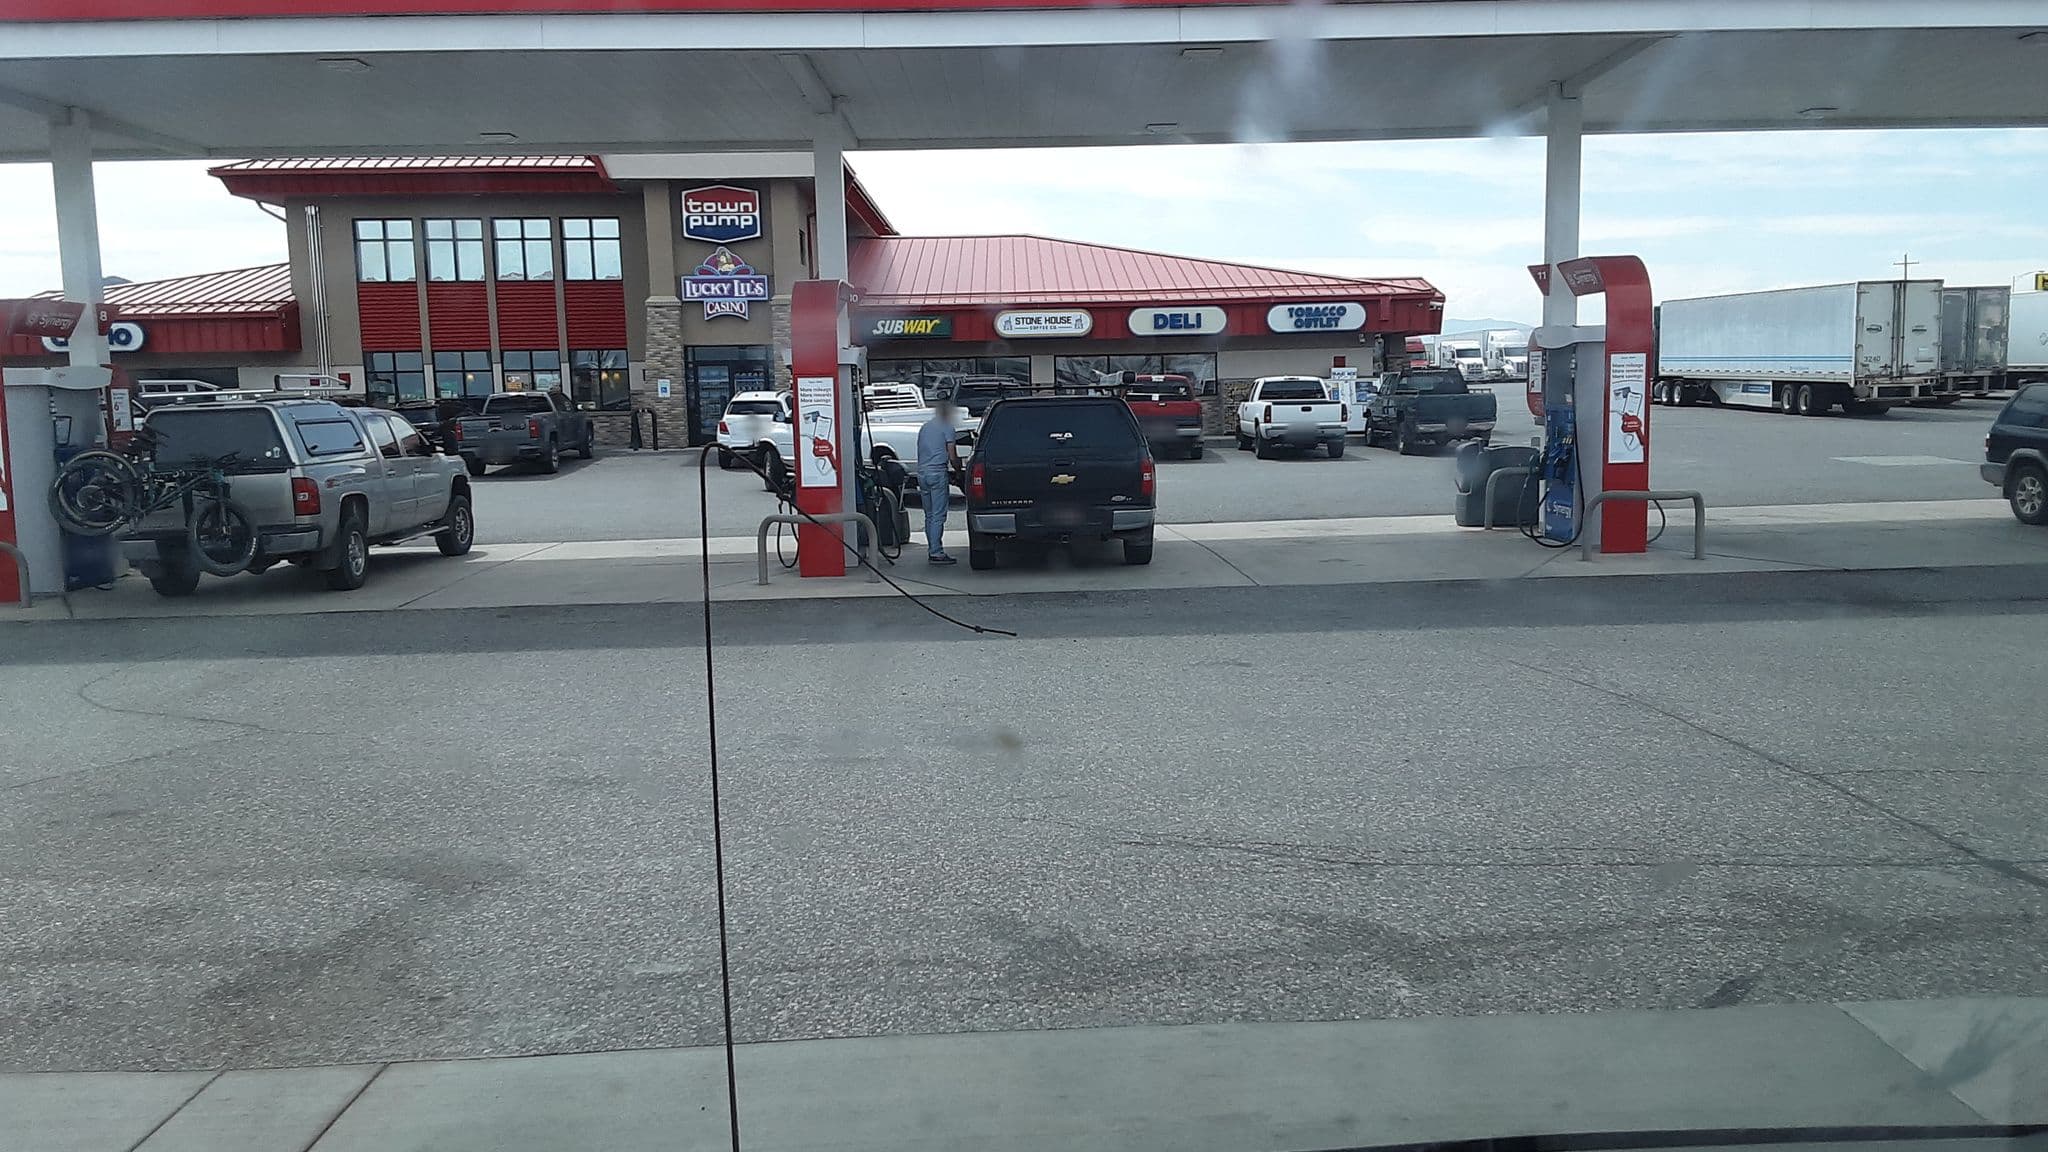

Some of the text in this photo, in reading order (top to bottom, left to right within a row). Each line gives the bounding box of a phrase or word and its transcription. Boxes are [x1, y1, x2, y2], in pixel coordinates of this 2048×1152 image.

[686, 198, 753, 213] town
[689, 215, 754, 230] pump
[706, 301, 746, 314] CASINO
[1288, 305, 1347, 318] TOBACCO
[99, 311, 108, 321] 8
[1014, 315, 1073, 326] STONE HOUSE
[1153, 312, 1202, 330] DELI
[872, 318, 941, 336] SUBWAY
[1294, 317, 1340, 329] OUTLET
